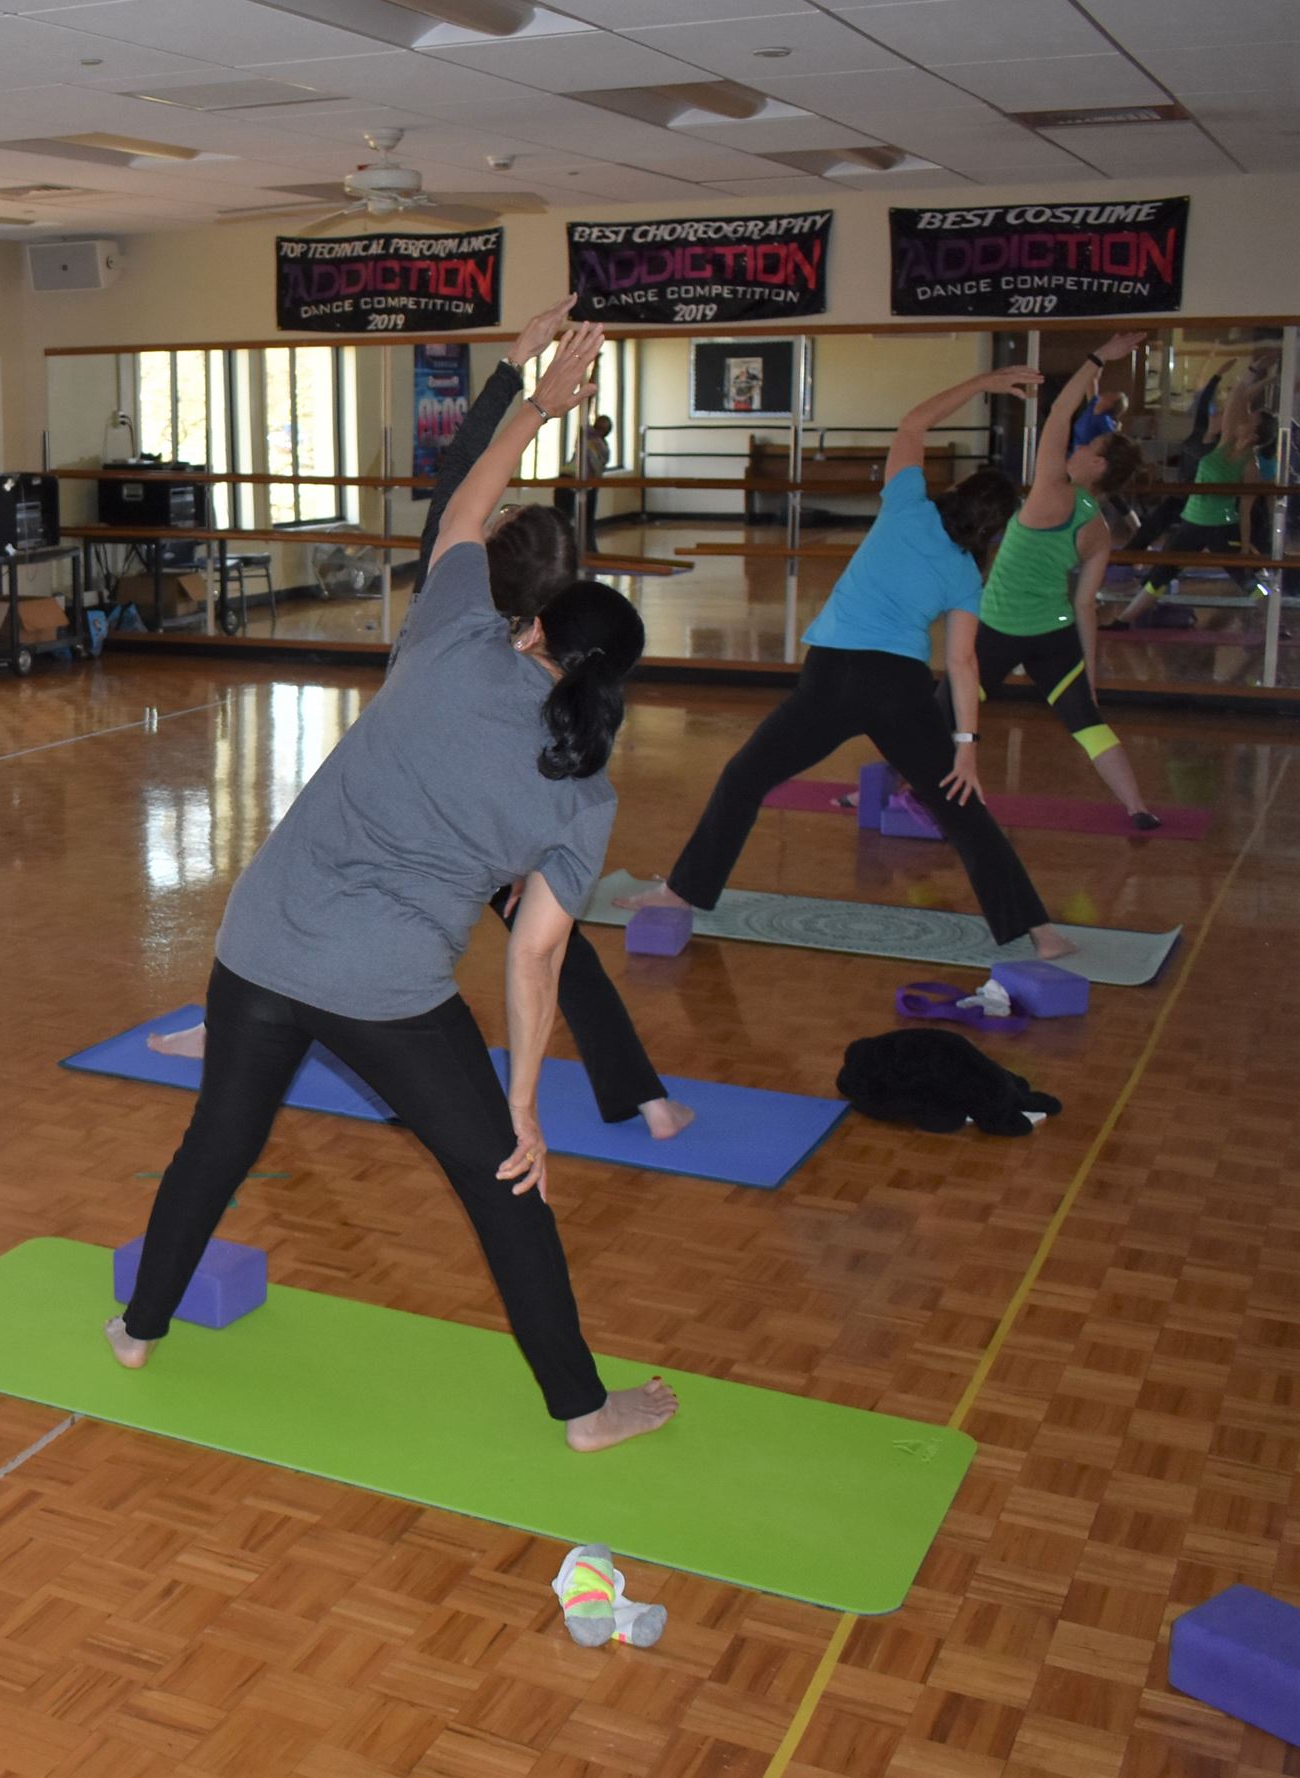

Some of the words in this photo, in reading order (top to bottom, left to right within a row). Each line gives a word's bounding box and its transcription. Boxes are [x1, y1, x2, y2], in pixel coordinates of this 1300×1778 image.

[574, 225, 632, 243] BEST
[632, 213, 831, 242] CHOREOGRAPHY
[917, 209, 1004, 229] BEST
[1005, 202, 1163, 225] COSTUME
[280, 241, 308, 257] TOP
[308, 238, 385, 259] TECHNICAL
[390, 232, 499, 258] PERFORMANCE
[899, 227, 1177, 287] ADDICTION
[283, 255, 496, 306] ADDICTION
[578, 239, 822, 296] ADDICTION
[593, 288, 659, 308] DANCE
[666, 285, 800, 303] COMPETITION
[916, 279, 992, 300] DANCE
[1001, 275, 1150, 296] COMPETITION
[301, 299, 354, 318] DANCE
[360, 296, 475, 313] COMPETITION
[673, 303, 718, 321] 2019
[1008, 295, 1057, 314] 2019
[366, 314, 405, 330] 2019
